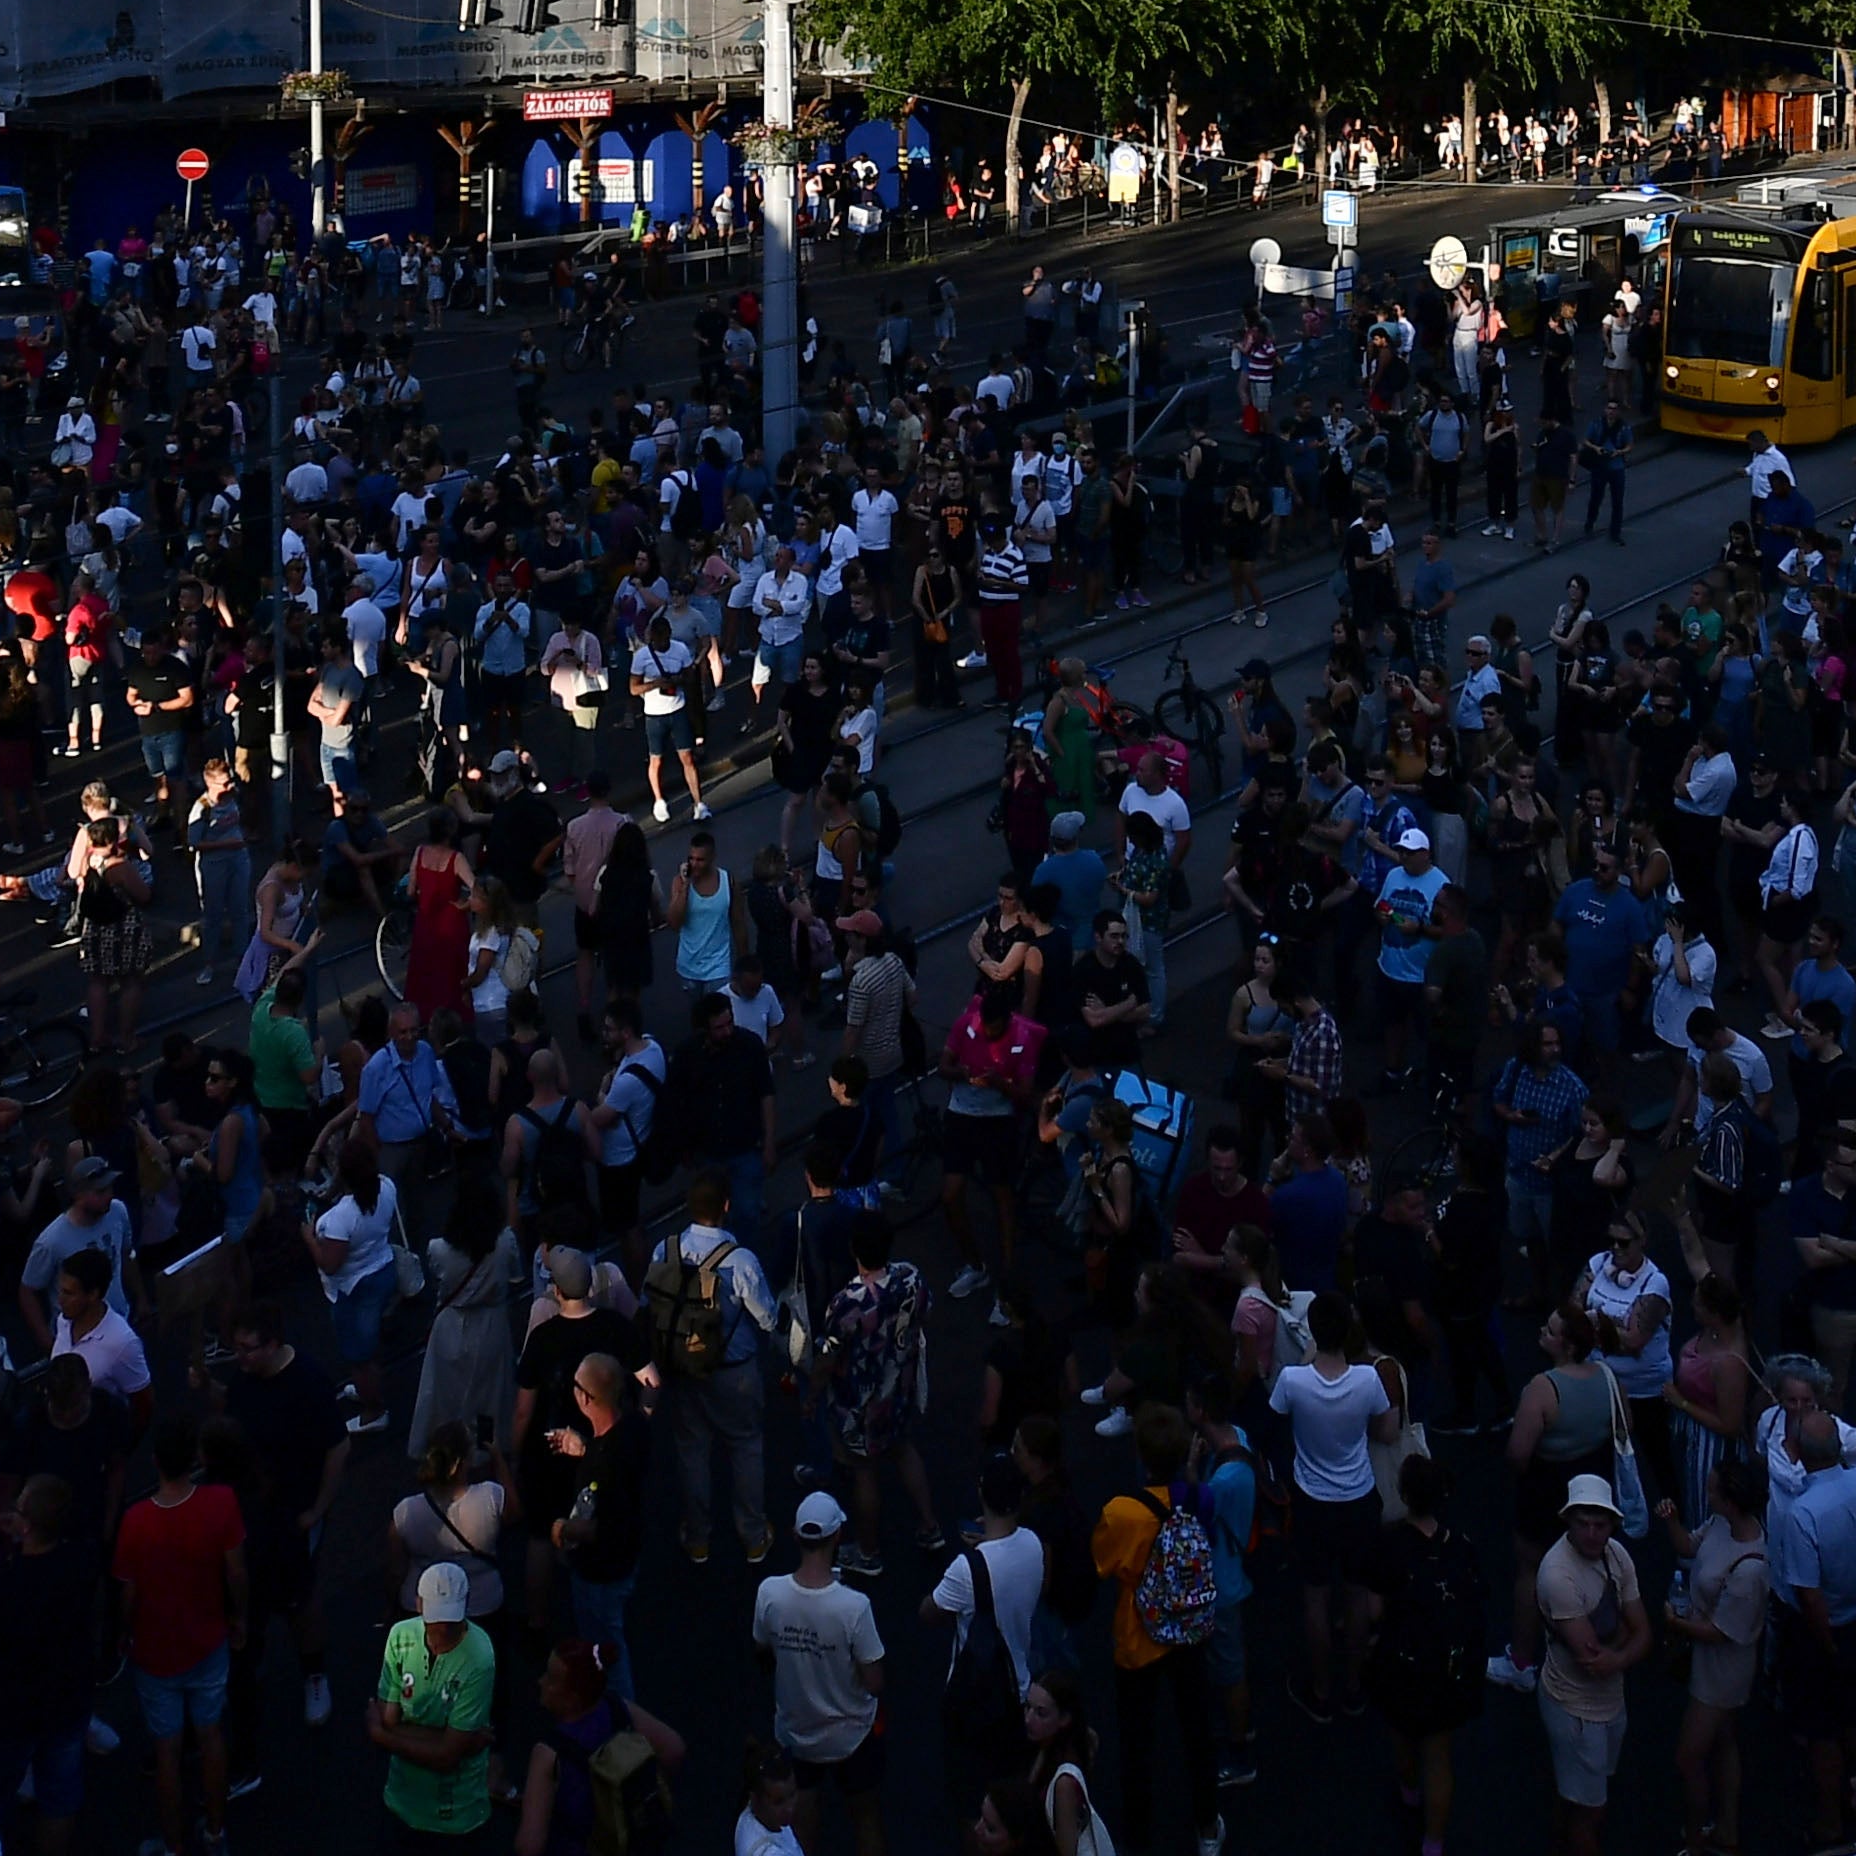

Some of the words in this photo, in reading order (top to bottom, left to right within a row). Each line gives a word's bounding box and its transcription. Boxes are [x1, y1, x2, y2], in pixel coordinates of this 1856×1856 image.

[511, 54, 568, 68] MAGYAR
[571, 51, 605, 66] ÉPÍTŐ
[722, 43, 766, 58] MAGYA
[526, 96, 610, 115] ZÁLOGFIÓK
[1131, 1147, 1158, 1167] olt
